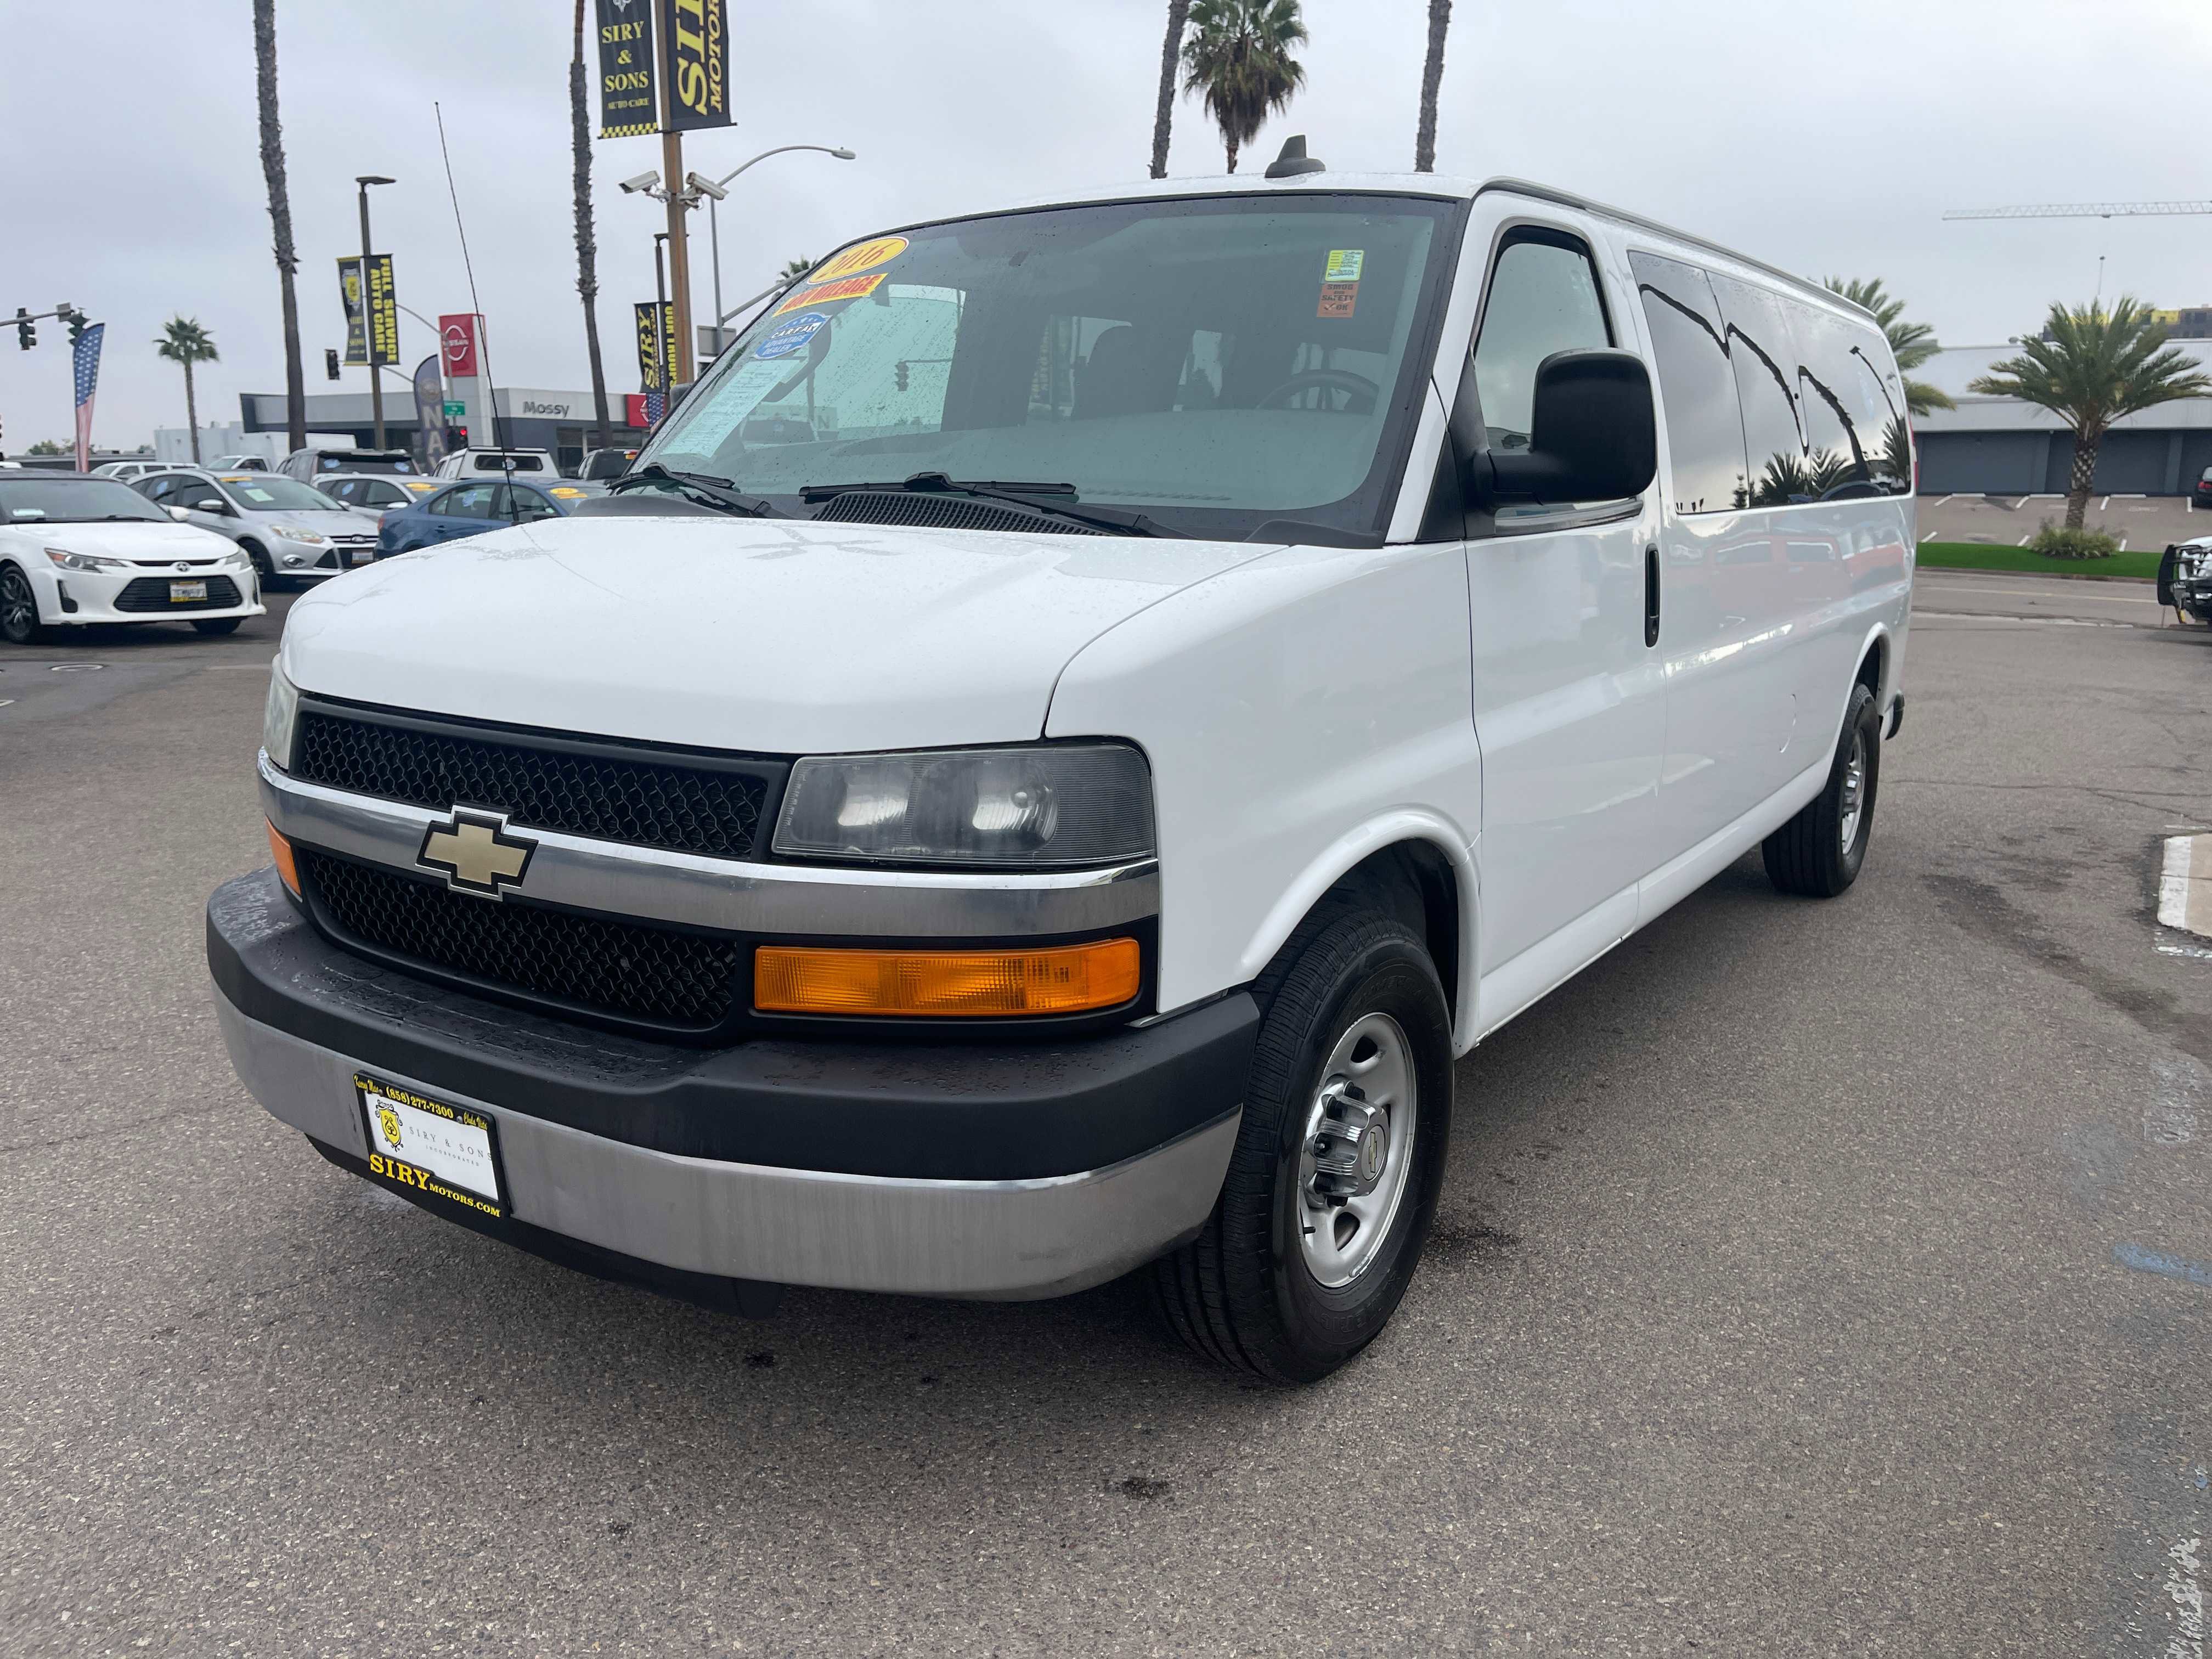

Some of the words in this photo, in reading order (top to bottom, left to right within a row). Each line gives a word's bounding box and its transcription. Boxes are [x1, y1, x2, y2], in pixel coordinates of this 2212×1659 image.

[601, 21, 645, 44] SIRY
[617, 49, 632, 65] &
[605, 71, 649, 93] SONS
[370, 268, 382, 310] AUTO
[384, 298, 397, 362] SERVICE
[771, 321, 822, 338] CARFAX
[638, 308, 654, 388] SIRY
[522, 401, 569, 418] Mossy
[386, 1086, 410, 1105] (858)
[410, 1096, 454, 1119] 277-7300
[409, 1126, 436, 1142] SIRY
[445, 1138, 452, 1148] &
[459, 1143, 492, 1161] SONS
[369, 1154, 431, 1191] SIRY
[429, 1182, 501, 1217] MOTORS.COM
